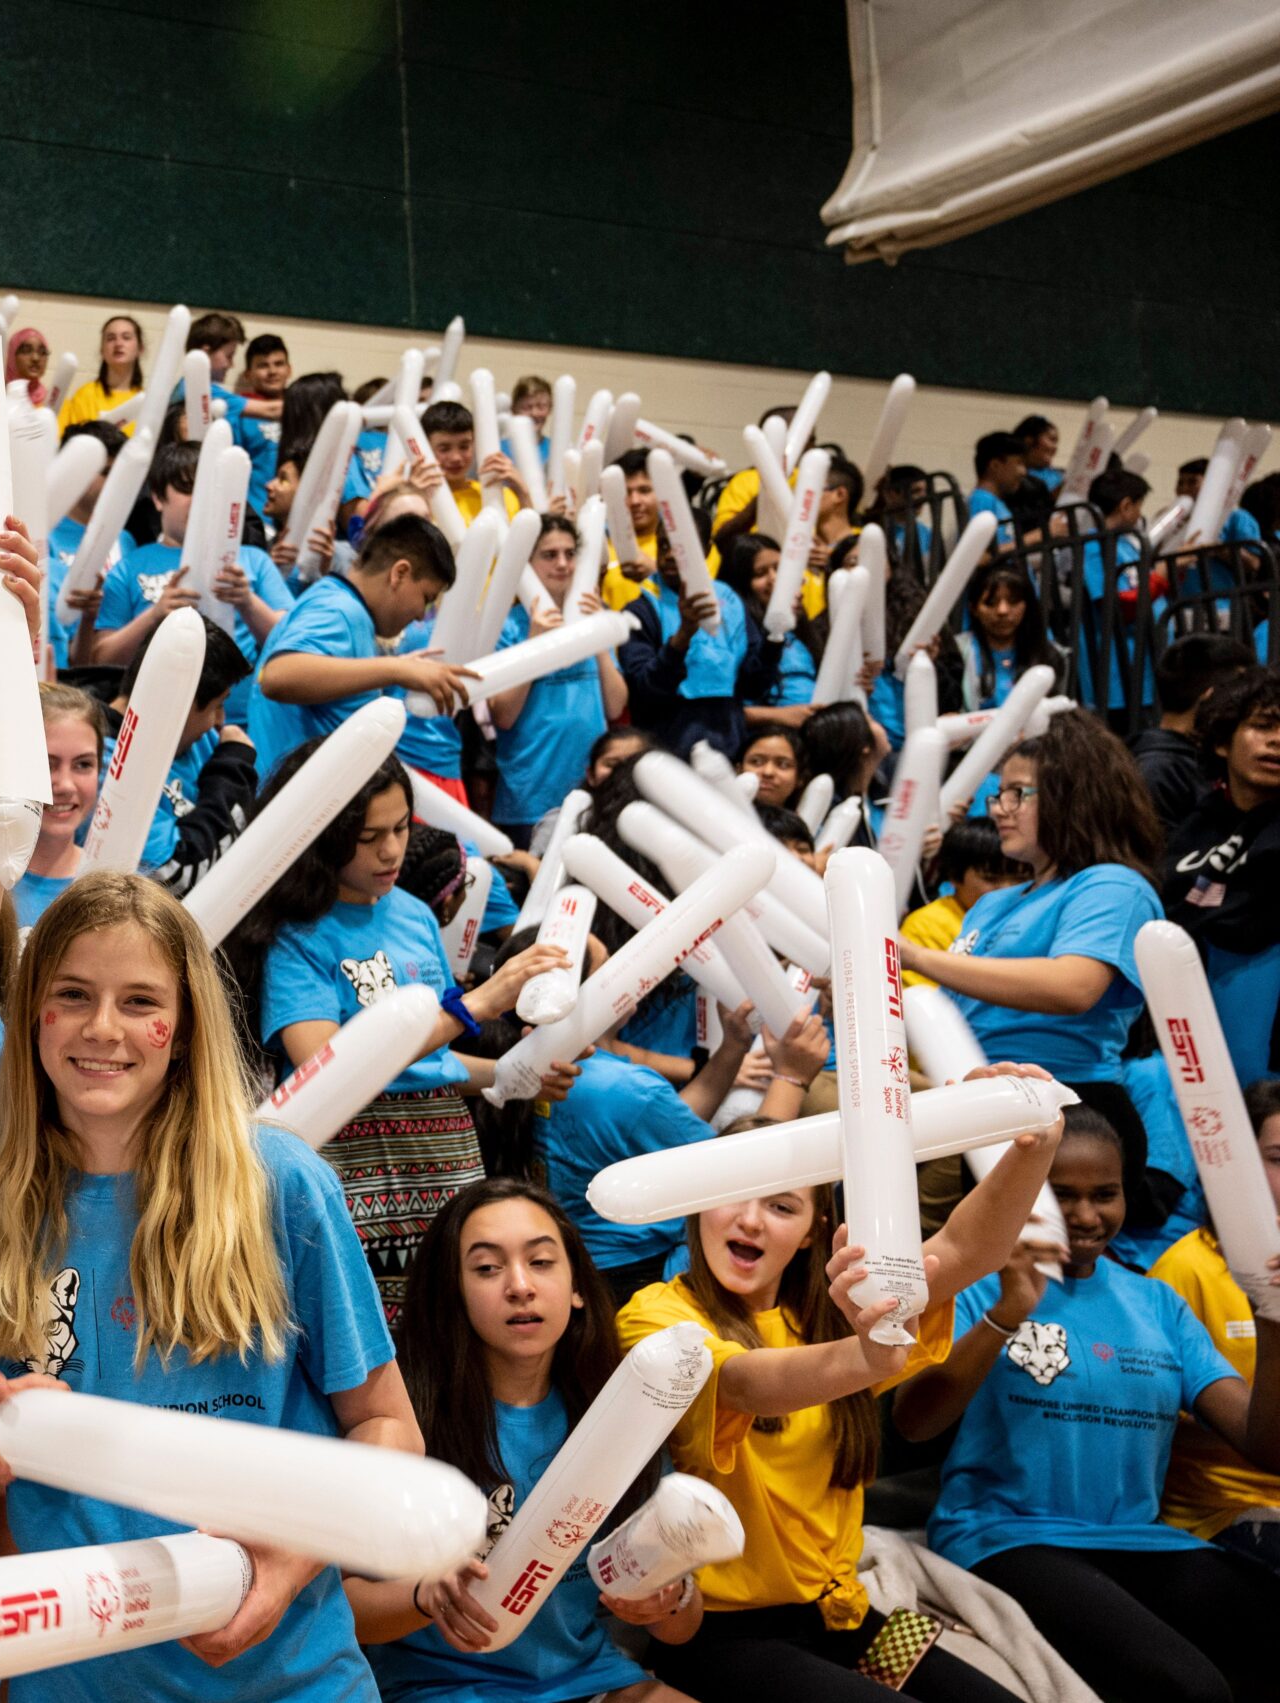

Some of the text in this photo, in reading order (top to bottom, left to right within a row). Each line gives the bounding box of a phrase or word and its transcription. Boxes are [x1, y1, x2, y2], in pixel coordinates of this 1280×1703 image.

[110, 707, 140, 781] ESPN
[885, 937, 904, 1021] ESPN
[843, 949, 861, 1109] GLOBAL PRESENTING SPONSOR
[1166, 1018, 1205, 1083] ESPN
[271, 1041, 335, 1110] ESPN
[883, 1086, 893, 1119] Sports
[894, 1088, 904, 1120] Unified
[213, 1394, 266, 1412] SCHOOL
[1009, 1393, 1060, 1410] KENMORE
[1063, 1400, 1101, 1413] UNIFIED
[1102, 1405, 1155, 1420] CHAMPION
[500, 1559, 554, 1616] ESPN
